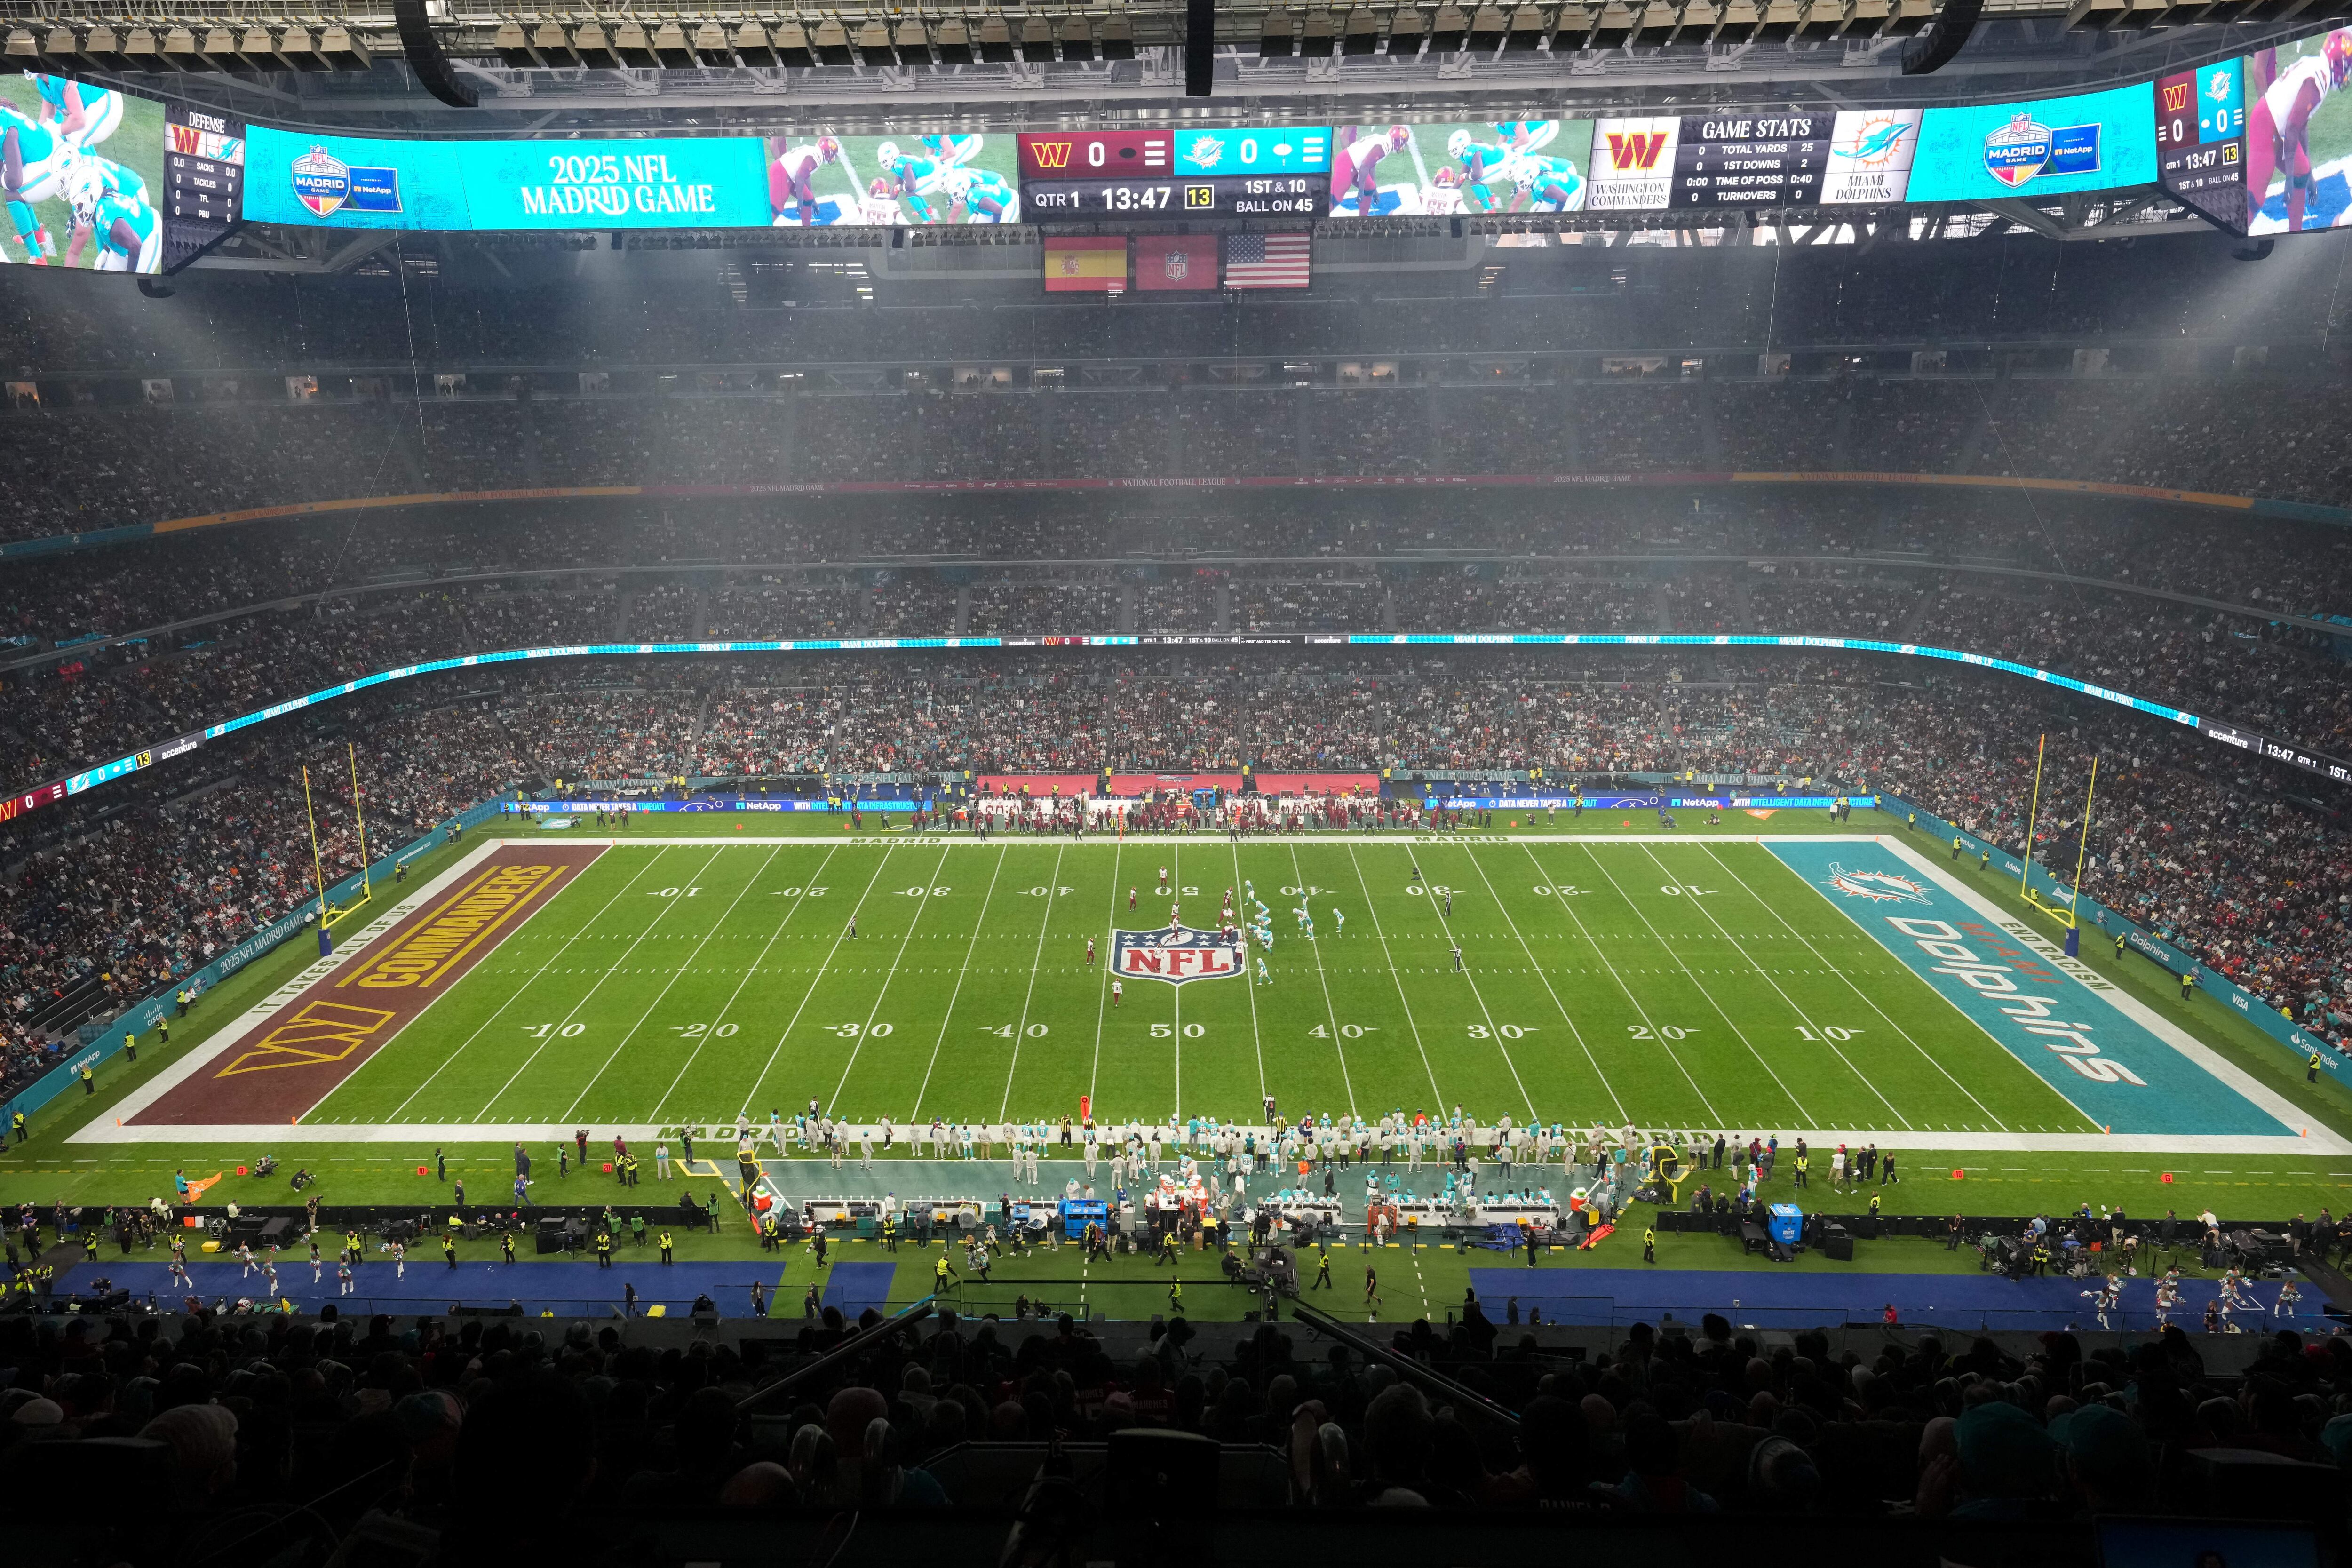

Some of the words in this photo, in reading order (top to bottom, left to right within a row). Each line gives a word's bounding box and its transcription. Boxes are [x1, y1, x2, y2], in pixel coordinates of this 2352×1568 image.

[189, 111, 224, 133] DEFENSE
[2012, 122, 2027, 132] NFL
[2217, 109, 2227, 132] 0
[1703, 121, 1751, 139] GAME
[1756, 119, 1811, 137] STATS
[2173, 119, 2183, 142] 0
[1031, 143, 1072, 167] W
[1089, 142, 1105, 167] 0
[1240, 139, 1257, 164] 0
[1605, 131, 1669, 170] W
[1699, 146, 1705, 155] 0
[1722, 146, 1752, 154] TOTAL
[1755, 144, 1787, 153] YARDS
[1801, 143, 1813, 152] 25
[1988, 145, 2045, 159] MADRID
[2225, 147, 2237, 161] 13
[312, 153, 325, 162] NFL
[2186, 150, 2216, 169] 13:47
[174, 157, 184, 167] 0.0
[197, 162, 214, 172] SACKS
[226, 167, 235, 177] 0.0
[549, 156, 620, 183] 2025
[623, 155, 677, 183] NFL
[1697, 162, 1702, 171] 0
[1743, 160, 1780, 169] DOWNS
[1801, 159, 1807, 167] 2
[194, 178, 216, 188] TACKLES
[296, 177, 344, 189] MADRID
[1687, 177, 1708, 186] 0:00
[1716, 177, 1739, 185] TIME
[1756, 175, 1783, 184] POSS
[1791, 175, 1812, 183] 0:40
[1848, 175, 1884, 186] MIAMI
[2231, 173, 2239, 181] 45
[1245, 180, 1272, 194] 1ST
[1275, 182, 1285, 192] &
[1288, 179, 1306, 192] 10
[1596, 183, 1664, 194] WASHINGTON
[2179, 181, 2190, 190] 1ST
[521, 186, 630, 215] MADRID
[635, 185, 715, 212] GAME
[1036, 194, 1066, 207] QTR
[1071, 191, 1079, 207] 1
[1102, 187, 1171, 209] 13:47
[1189, 189, 1209, 205] 13
[1717, 191, 1776, 201] TURNOVERS
[1796, 190, 1802, 199] 0
[1836, 188, 1891, 199] DOLPHINS
[1237, 201, 1269, 212] BALL
[1272, 200, 1292, 211] ON
[1295, 199, 1312, 211] 45
[1592, 195, 1666, 206] COMMANDERS
[199, 210, 209, 218] PBU
[1168, 265, 1185, 275] NFL
[1779, 637, 1803, 645] MIAMI
[1805, 637, 1844, 647] DOLPHINS
[527, 648, 550, 658] MIAMI
[552, 646, 588, 656] DOLPHINS
[1963, 653, 1982, 665] PHINS
[2084, 683, 2102, 698] MIAMI
[2104, 689, 2133, 707] DOLPHINS
[282, 697, 309, 713] DOLPHINS
[2209, 730, 2248, 748] accenture
[162, 741, 197, 759] accenture
[2267, 744, 2294, 761] 13:47
[2298, 756, 2310, 765] QTR
[137, 752, 149, 765] 13
[98, 768, 105, 780] 0
[2330, 766, 2347, 779] 1ST
[1696, 775, 1725, 784] MIAMI
[25, 795, 33, 808] 0
[747, 802, 781, 811] NetApp
[1683, 799, 1718, 807] NetApp
[1960, 837, 1975, 849] NetApp
[408, 845, 423, 857] Illustrated
[2005, 861, 2021, 874] Adobe
[660, 887, 703, 897] 10
[783, 887, 829, 897] 20
[906, 887, 951, 897] 30
[1031, 887, 1074, 897] 40
[1155, 886, 1199, 897] 50
[1280, 886, 1324, 897] 40
[1406, 886, 1450, 895] 30
[1533, 886, 1579, 896] 20
[1661, 886, 1707, 896] 10
[358, 865, 551, 987] COMMANDERS
[221, 952, 239, 974] 2025
[240, 945, 255, 961] NFL
[254, 926, 284, 952] MADRID
[284, 913, 304, 933] GAME
[2130, 932, 2170, 962] Dolphins
[251, 1002, 282, 1013] IT
[277, 961, 339, 995] TAKES
[340, 937, 373, 955] ALL
[366, 921, 392, 932] OF
[387, 905, 416, 916] US
[1955, 922, 2064, 984] MIAMI
[2000, 923, 2042, 941] END
[2034, 947, 2115, 990] RACISM
[1127, 949, 1229, 977] NFL
[1883, 916, 2148, 1087] Dolphins
[2233, 992, 2248, 1011] VISA
[530, 1023, 585, 1037] 10
[680, 1023, 739, 1037] 20
[836, 1023, 893, 1037] 30
[993, 1023, 1049, 1037] 40
[1150, 1024, 1205, 1038] 50
[1308, 1024, 1364, 1038] 40
[1467, 1025, 1524, 1038] 30
[1627, 1026, 1686, 1040] 20
[1794, 1026, 1852, 1040] 10
[77, 1050, 100, 1070] NetApp
